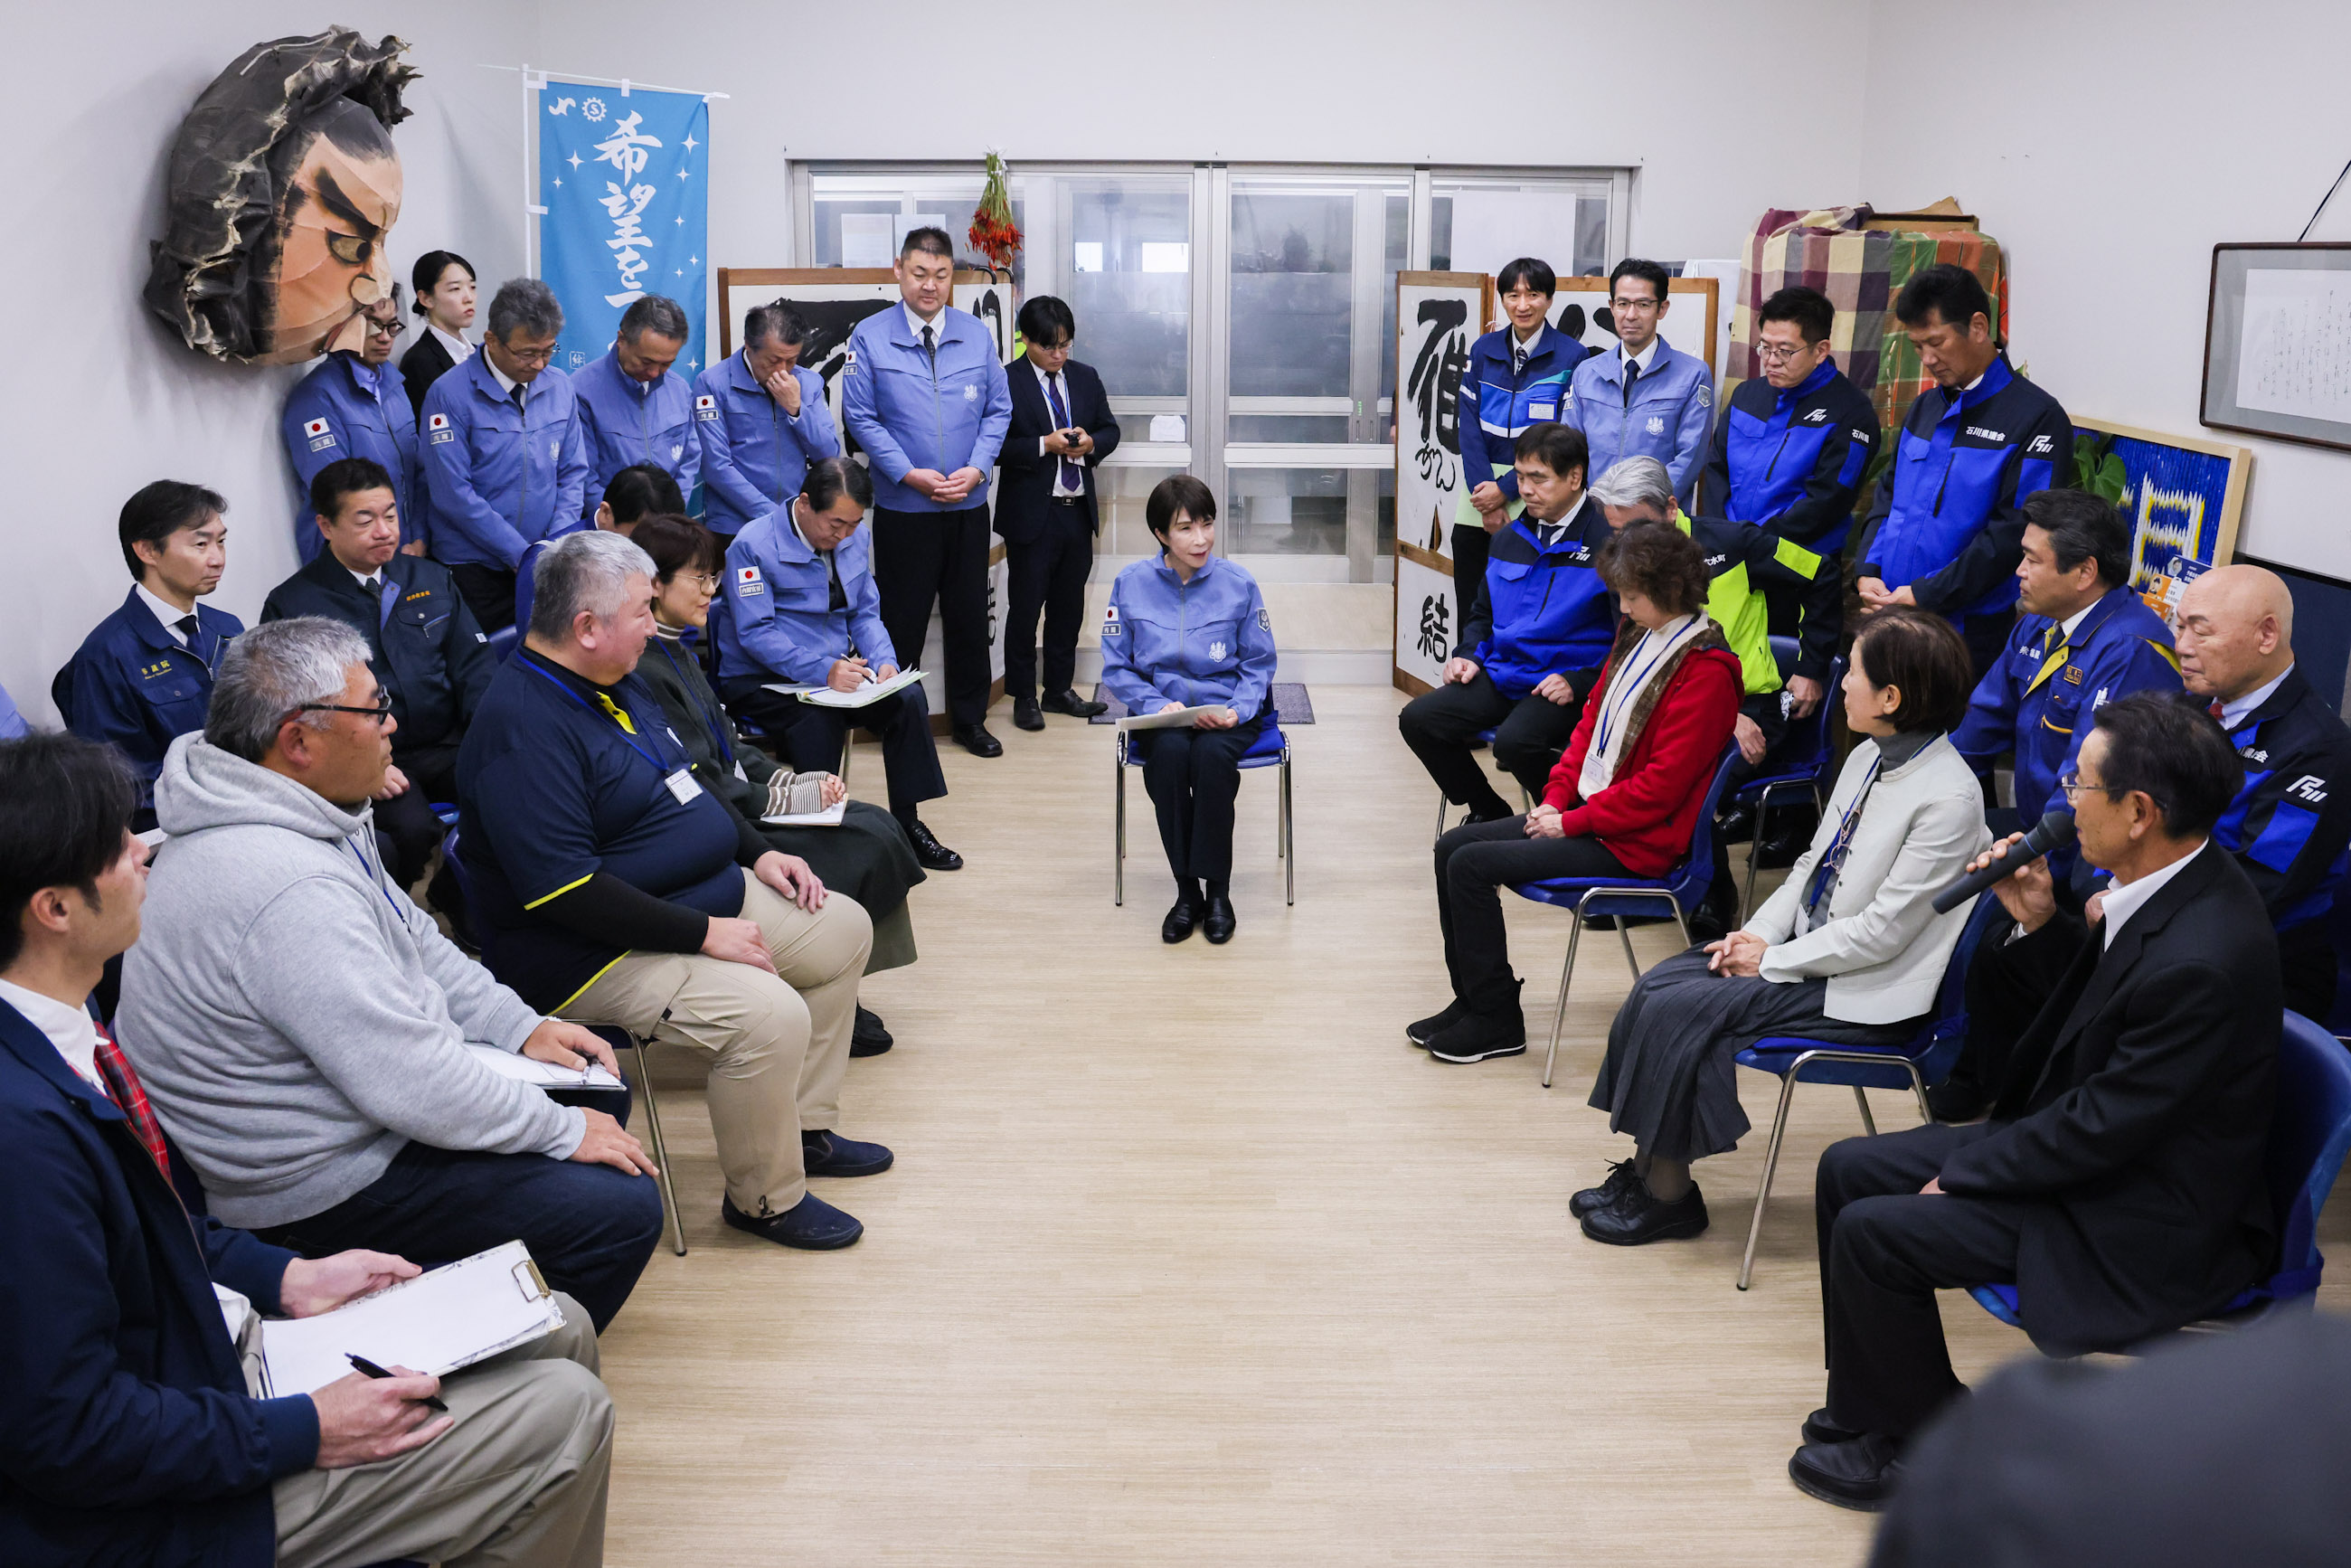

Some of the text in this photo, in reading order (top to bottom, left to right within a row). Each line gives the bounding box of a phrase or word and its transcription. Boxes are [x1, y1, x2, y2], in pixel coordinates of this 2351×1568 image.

[593, 109, 663, 308] 希望を
[1417, 592, 1449, 664] 結
